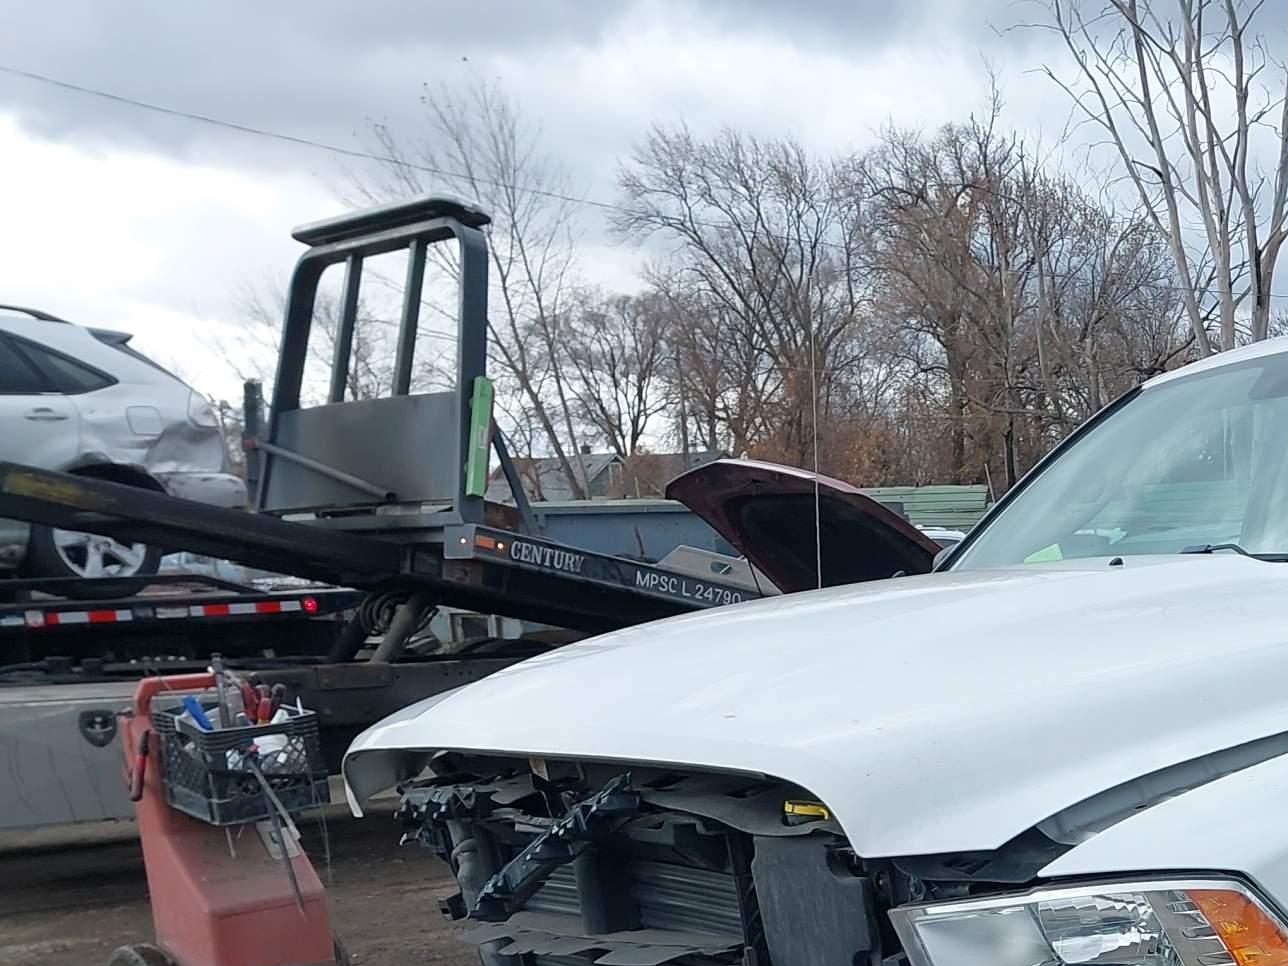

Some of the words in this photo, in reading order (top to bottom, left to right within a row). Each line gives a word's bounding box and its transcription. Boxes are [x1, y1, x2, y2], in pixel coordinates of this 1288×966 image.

[510, 540, 585, 573] CENTURY
[636, 570, 678, 593] MPSC
[681, 581, 692, 597] L
[694, 584, 741, 605] 24790
